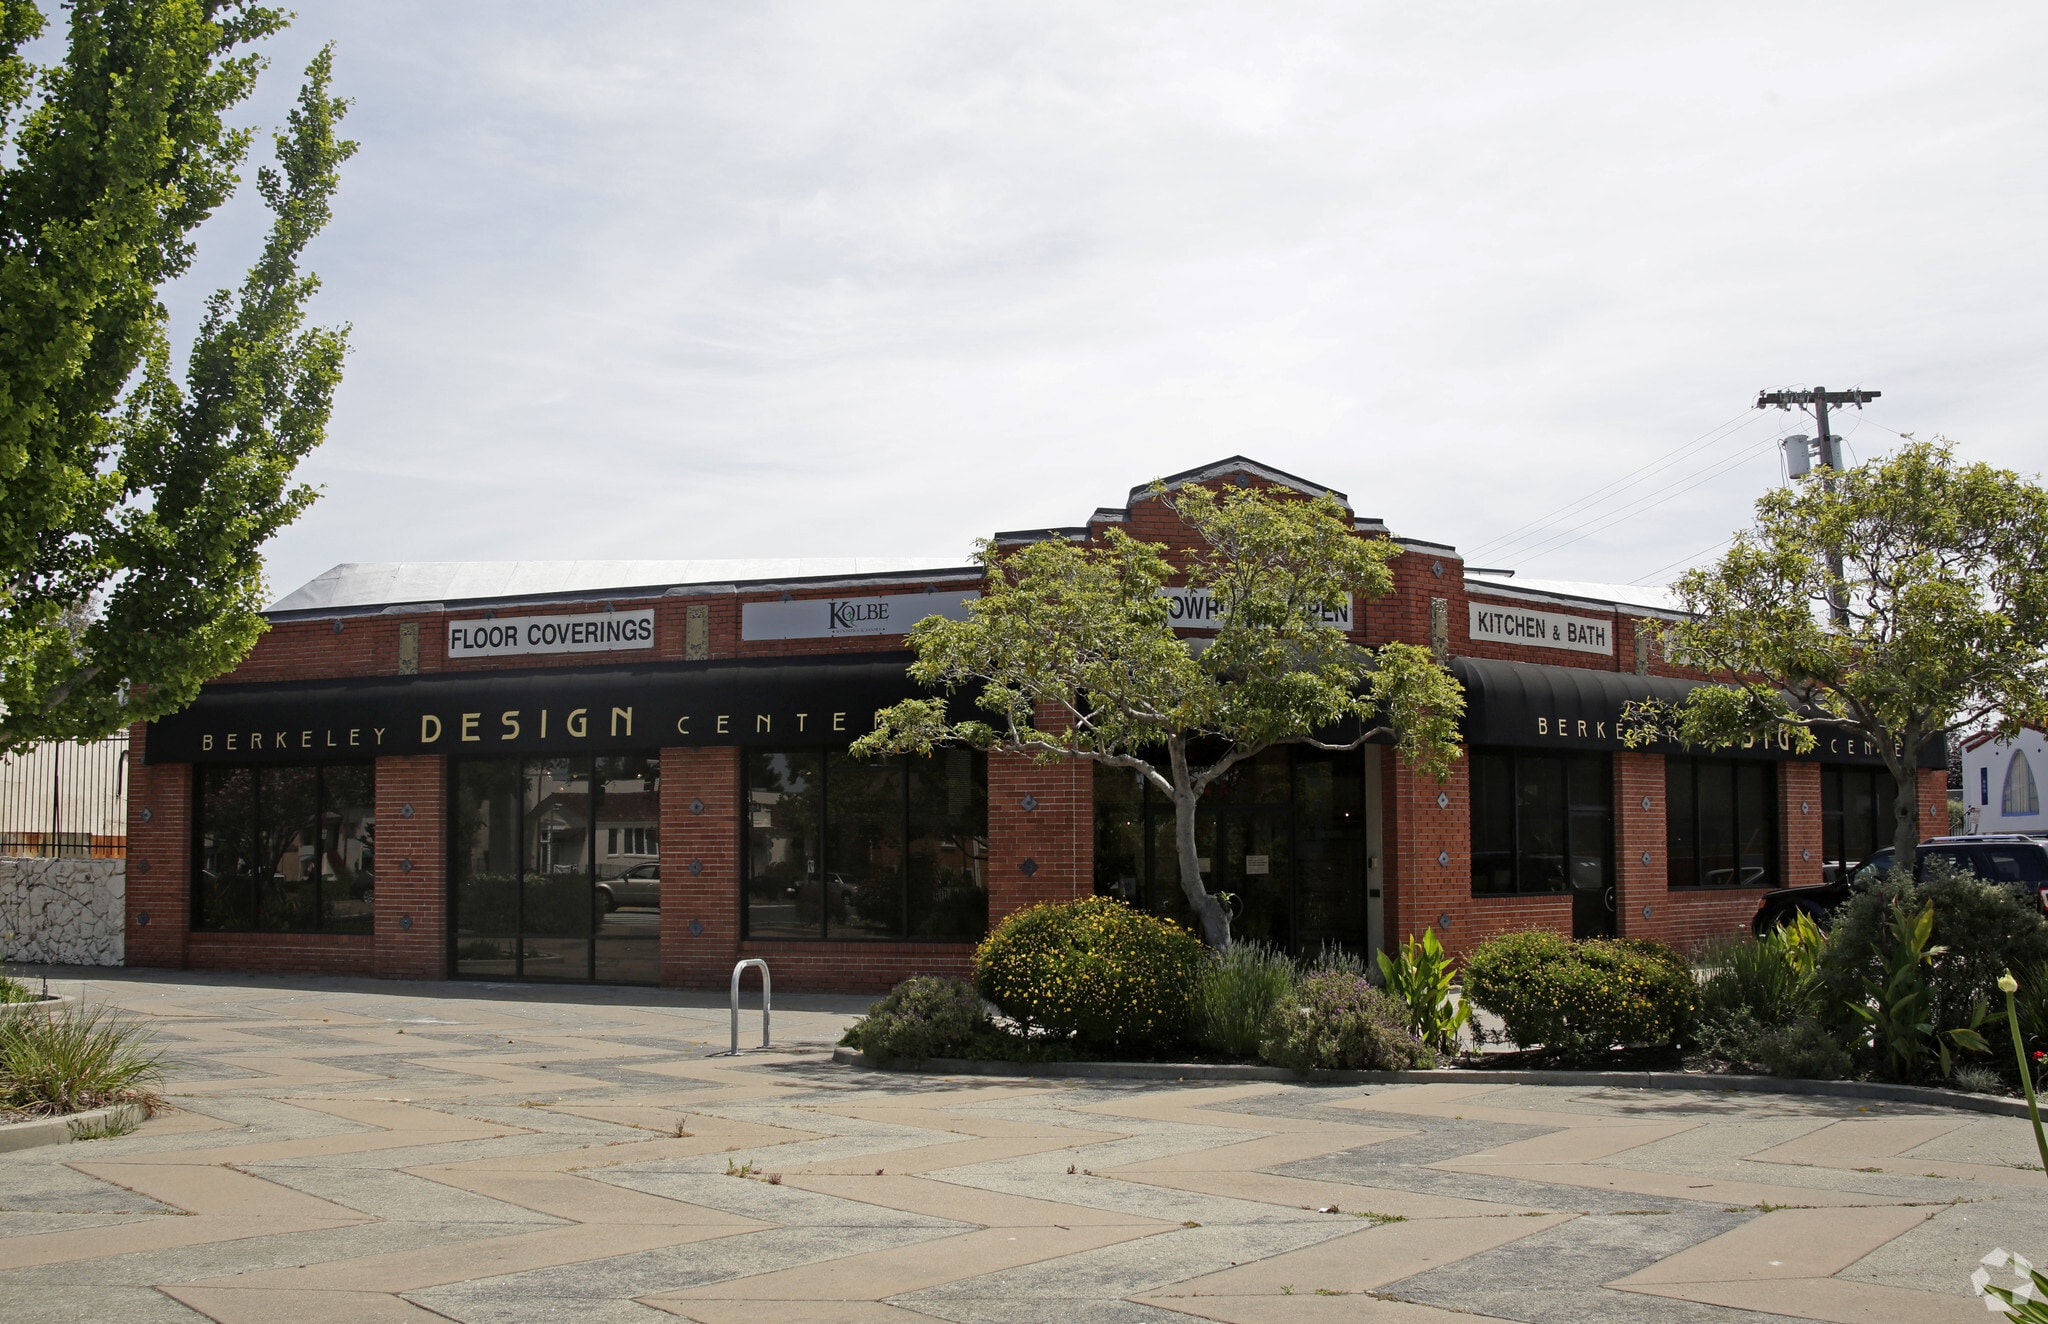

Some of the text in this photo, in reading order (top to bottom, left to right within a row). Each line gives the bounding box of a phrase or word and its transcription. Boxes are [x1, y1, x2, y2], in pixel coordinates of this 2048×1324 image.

[827, 601, 890, 629] KOLBE
[1302, 599, 1349, 623] PEN
[451, 618, 652, 650] FLOOR COVERINGS
[1478, 611, 1605, 647] KITCHEN & BATH
[202, 727, 386, 751] BERKELEY
[420, 706, 633, 744] DESIGN
[1538, 717, 1678, 744] BERKEY
